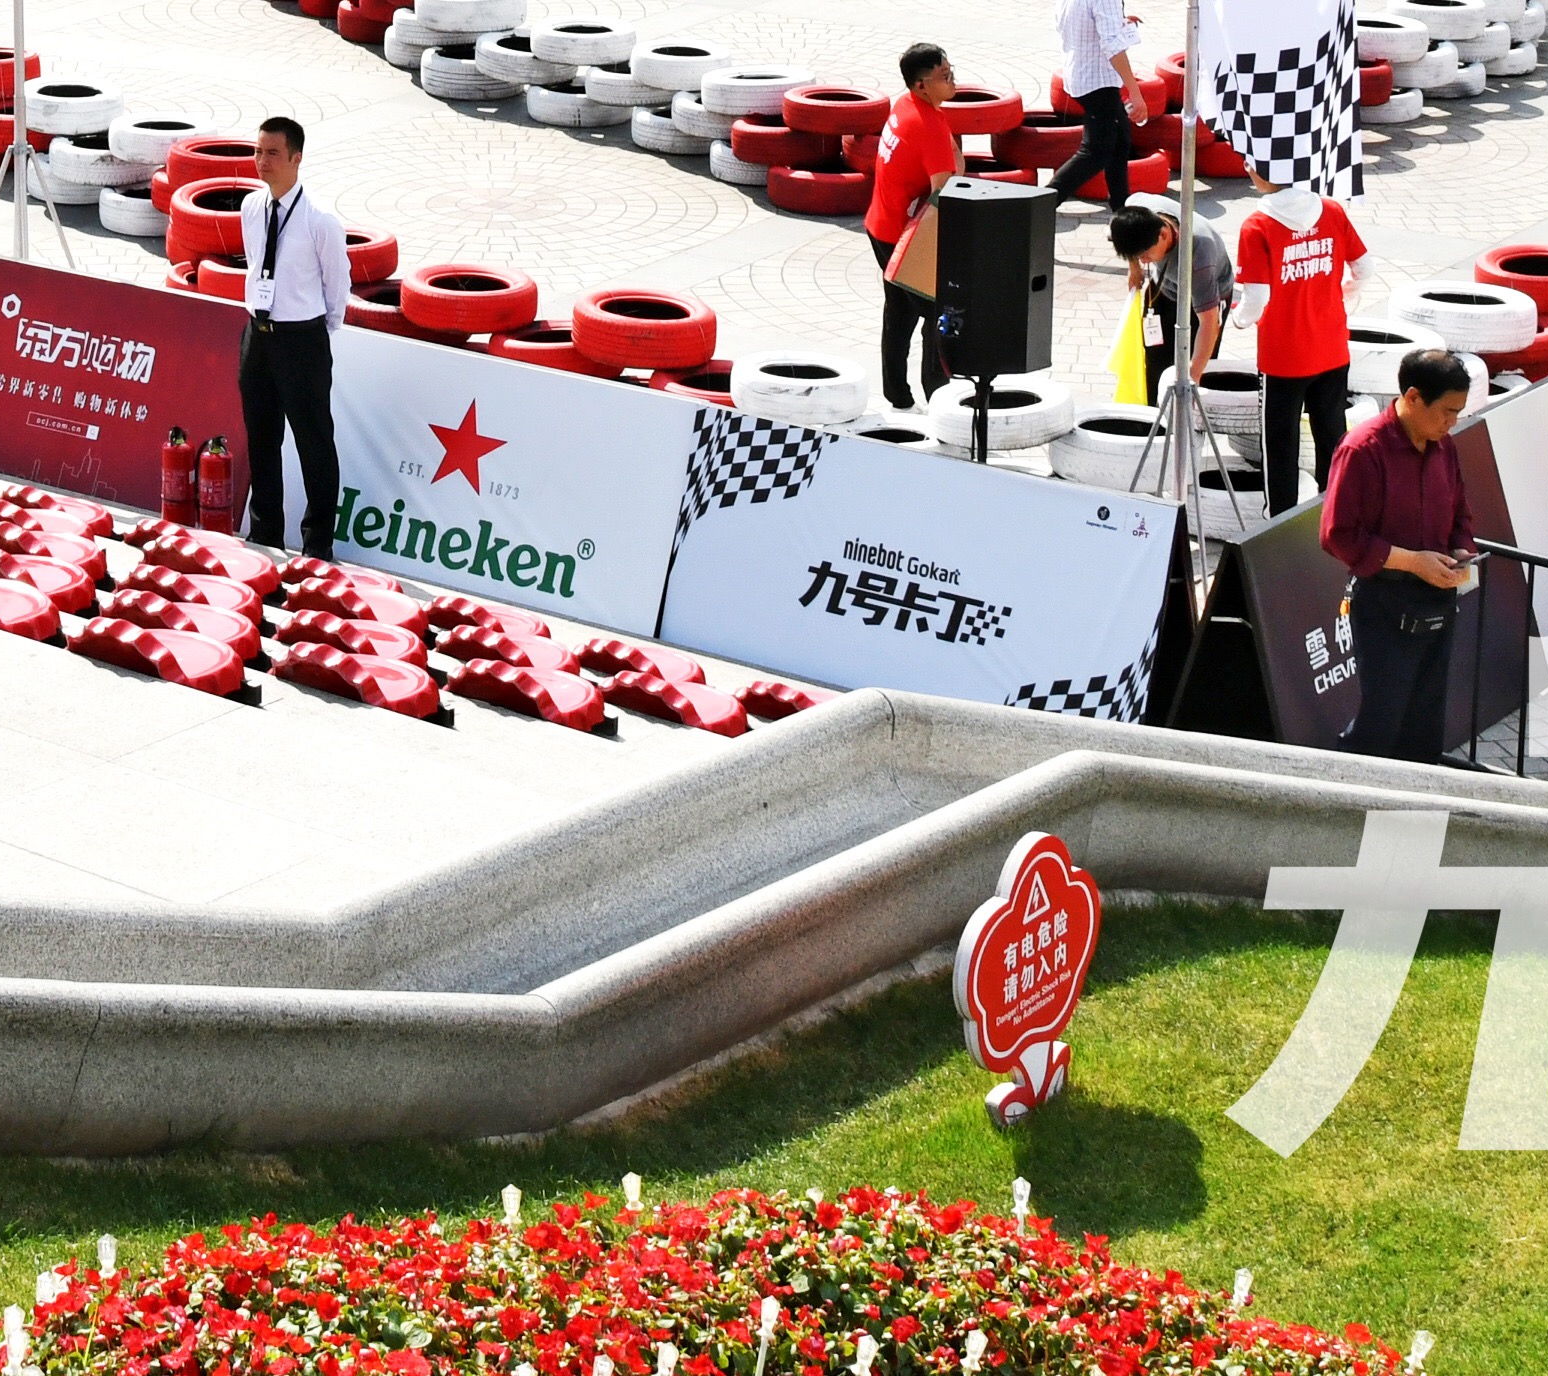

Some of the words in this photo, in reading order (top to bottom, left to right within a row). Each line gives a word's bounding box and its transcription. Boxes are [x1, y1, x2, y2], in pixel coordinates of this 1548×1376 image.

[16, 317, 157, 386] 东方购物
[73, 389, 149, 424] 购物新体验
[35, 415, 82, 435] ocj.com.cn
[398, 458, 428, 483] EST.
[487, 477, 523, 502] 1873
[1132, 530, 1150, 539] OPT
[843, 537, 904, 573] ninebot
[907, 556, 962, 587] Gokart
[797, 559, 985, 645] 九号卡丁
[1003, 908, 1069, 972] 有电危险
[1003, 940, 1067, 1005] 请勿入内
[1059, 970, 1072, 987] Risk
